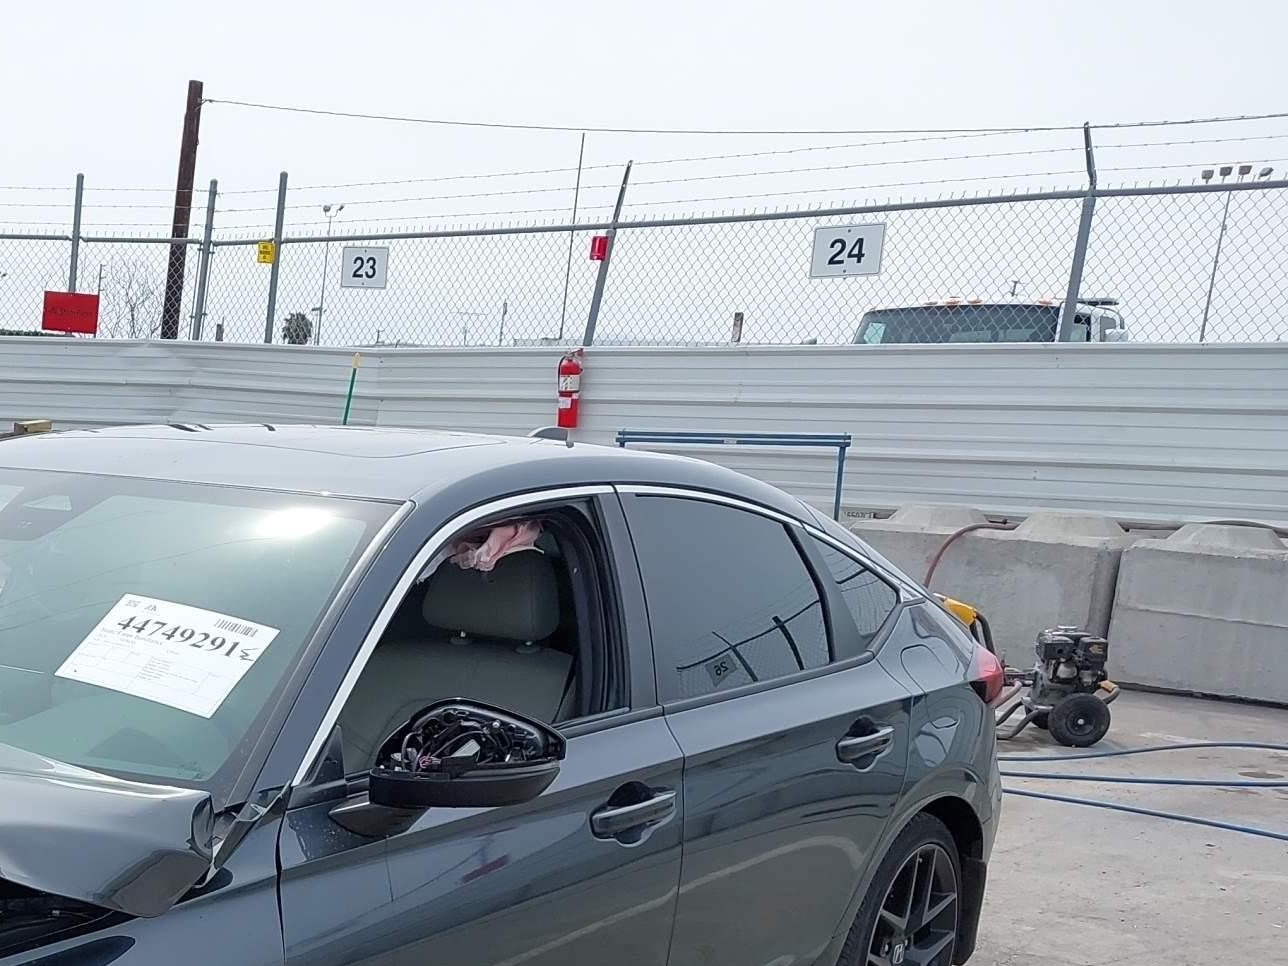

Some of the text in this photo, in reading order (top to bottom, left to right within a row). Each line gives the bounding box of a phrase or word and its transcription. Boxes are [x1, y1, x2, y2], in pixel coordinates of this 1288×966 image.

[827, 237, 866, 265] 24
[352, 256, 377, 279] 23
[117, 615, 240, 657] 44749291
